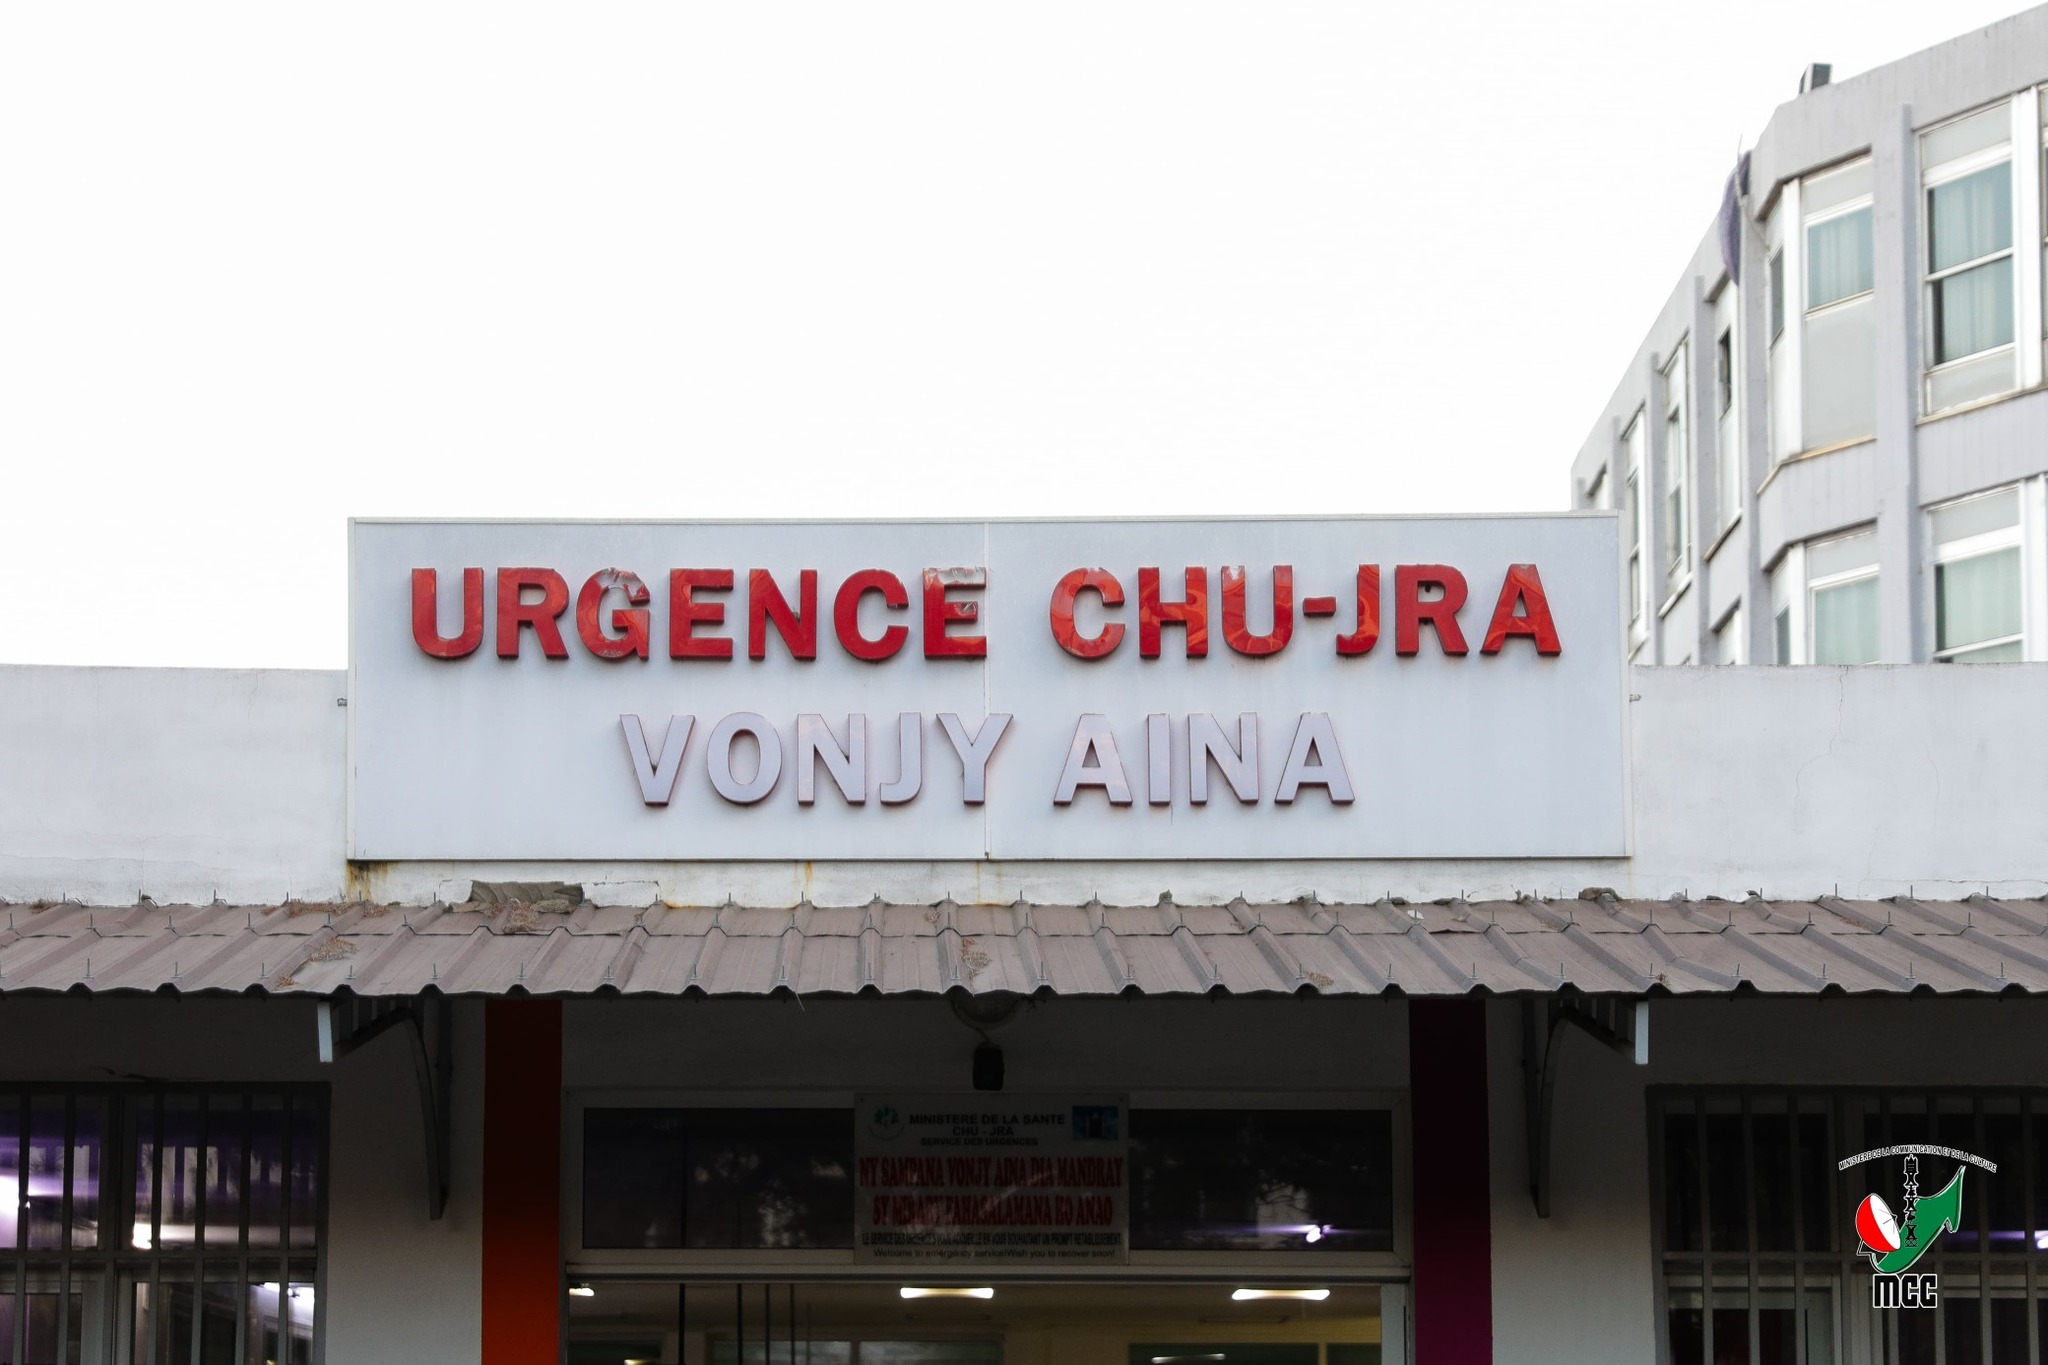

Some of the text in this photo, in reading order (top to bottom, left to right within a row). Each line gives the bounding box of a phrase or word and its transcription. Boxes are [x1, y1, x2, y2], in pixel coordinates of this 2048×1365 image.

[410, 563, 1563, 661] URGENCE CHU-JRA
[619, 711, 1356, 806] VONJY AINA
[909, 1113, 1065, 1125] MINISTERE DE LA SANTE
[921, 1137, 1039, 1146] SERVICE DES URGENCES
[952, 1126, 979, 1136] CHU
[990, 1126, 1015, 1136] JRA
[860, 1156, 879, 1187] NY
[947, 1156, 992, 1187] VONJY
[995, 1156, 1027, 1187] AINA
[1030, 1156, 1054, 1187] DIA
[1057, 1156, 1124, 1187] MANDRAY
[873, 1195, 890, 1225] SY
[1076, 1195, 1113, 1225] ANAO
[873, 1248, 912, 1257] Welcome
[915, 1249, 924, 1257] to
[926, 1249, 971, 1259] emergency
[1030, 1250, 1045, 1259] you
[1047, 1249, 1056, 1257] to
[1092, 1249, 1115, 1257] soon!
